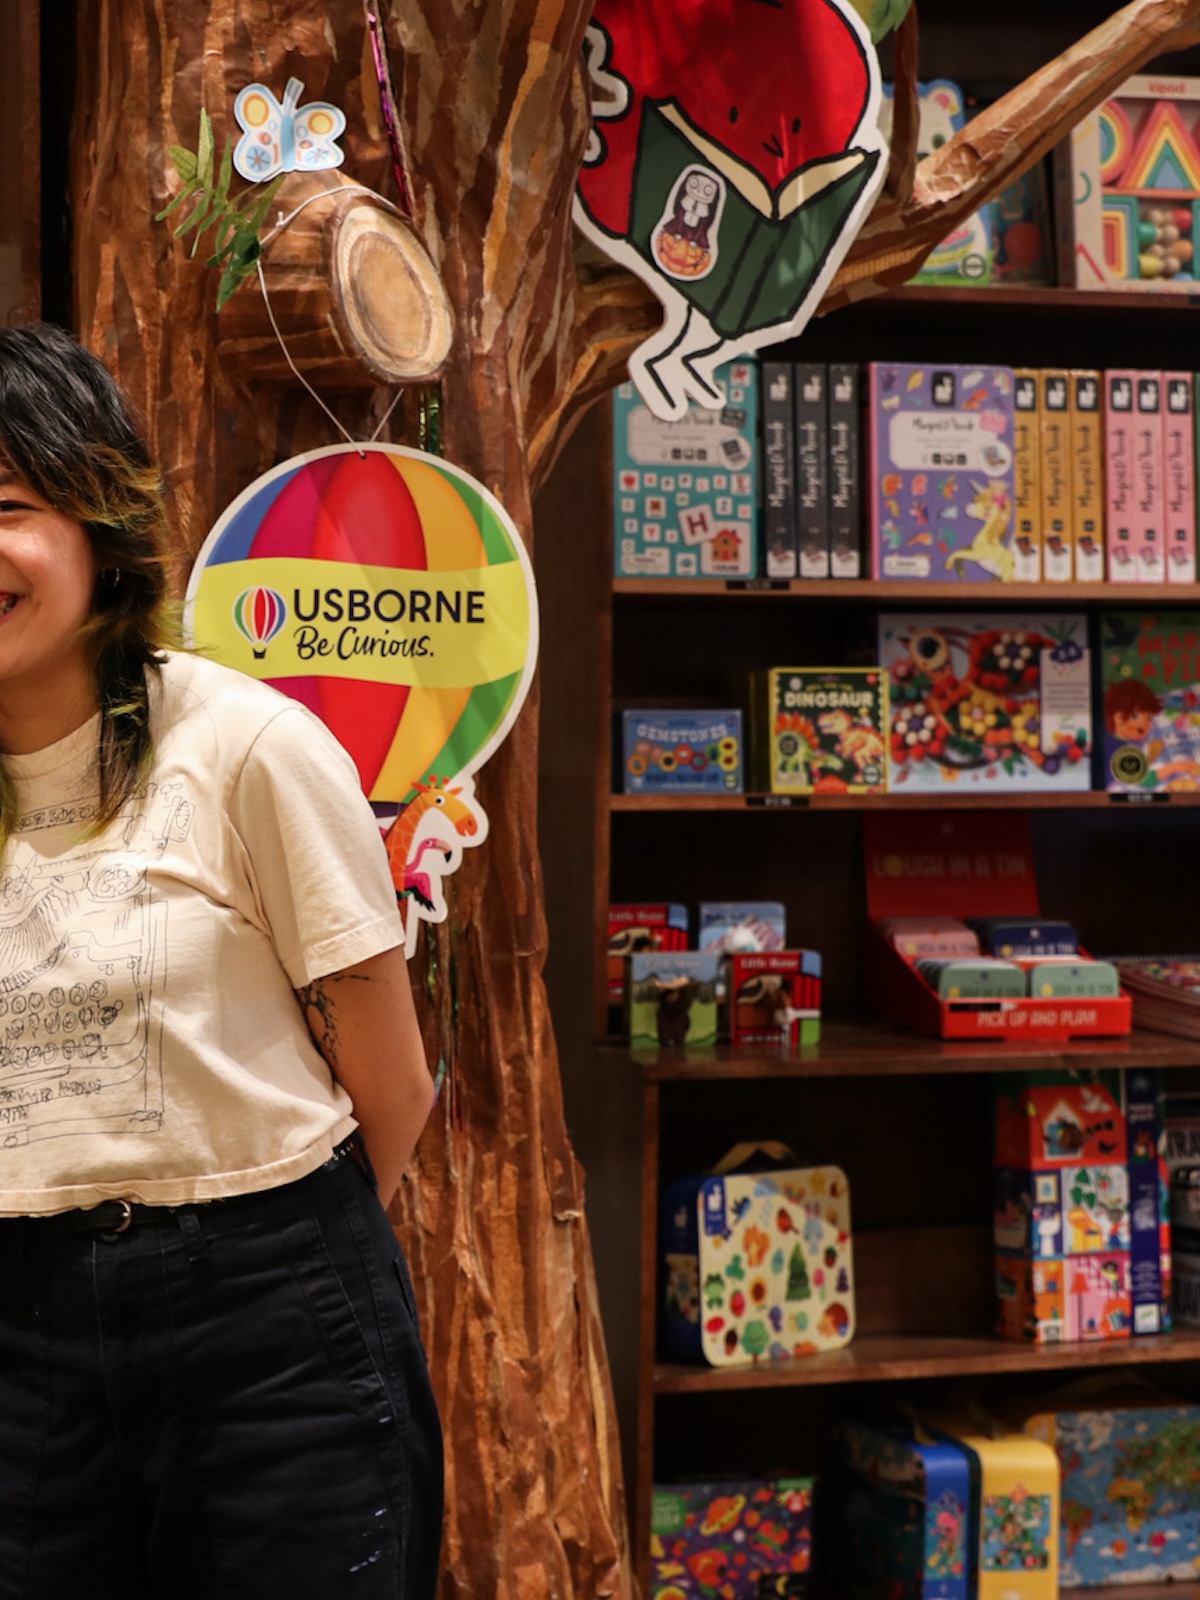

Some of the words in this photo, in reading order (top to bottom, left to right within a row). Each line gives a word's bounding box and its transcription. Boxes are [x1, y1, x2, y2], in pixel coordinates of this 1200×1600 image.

[293, 588, 485, 624] USBORNE
[293, 625, 335, 661] Be
[336, 625, 435, 661] Curious.
[783, 690, 875, 709] DINOSAUR
[637, 723, 729, 744] GEMSTONES
[977, 1010, 1007, 1028] PICK
[1009, 1010, 1028, 1028] UP
[1029, 1010, 1058, 1027] AND
